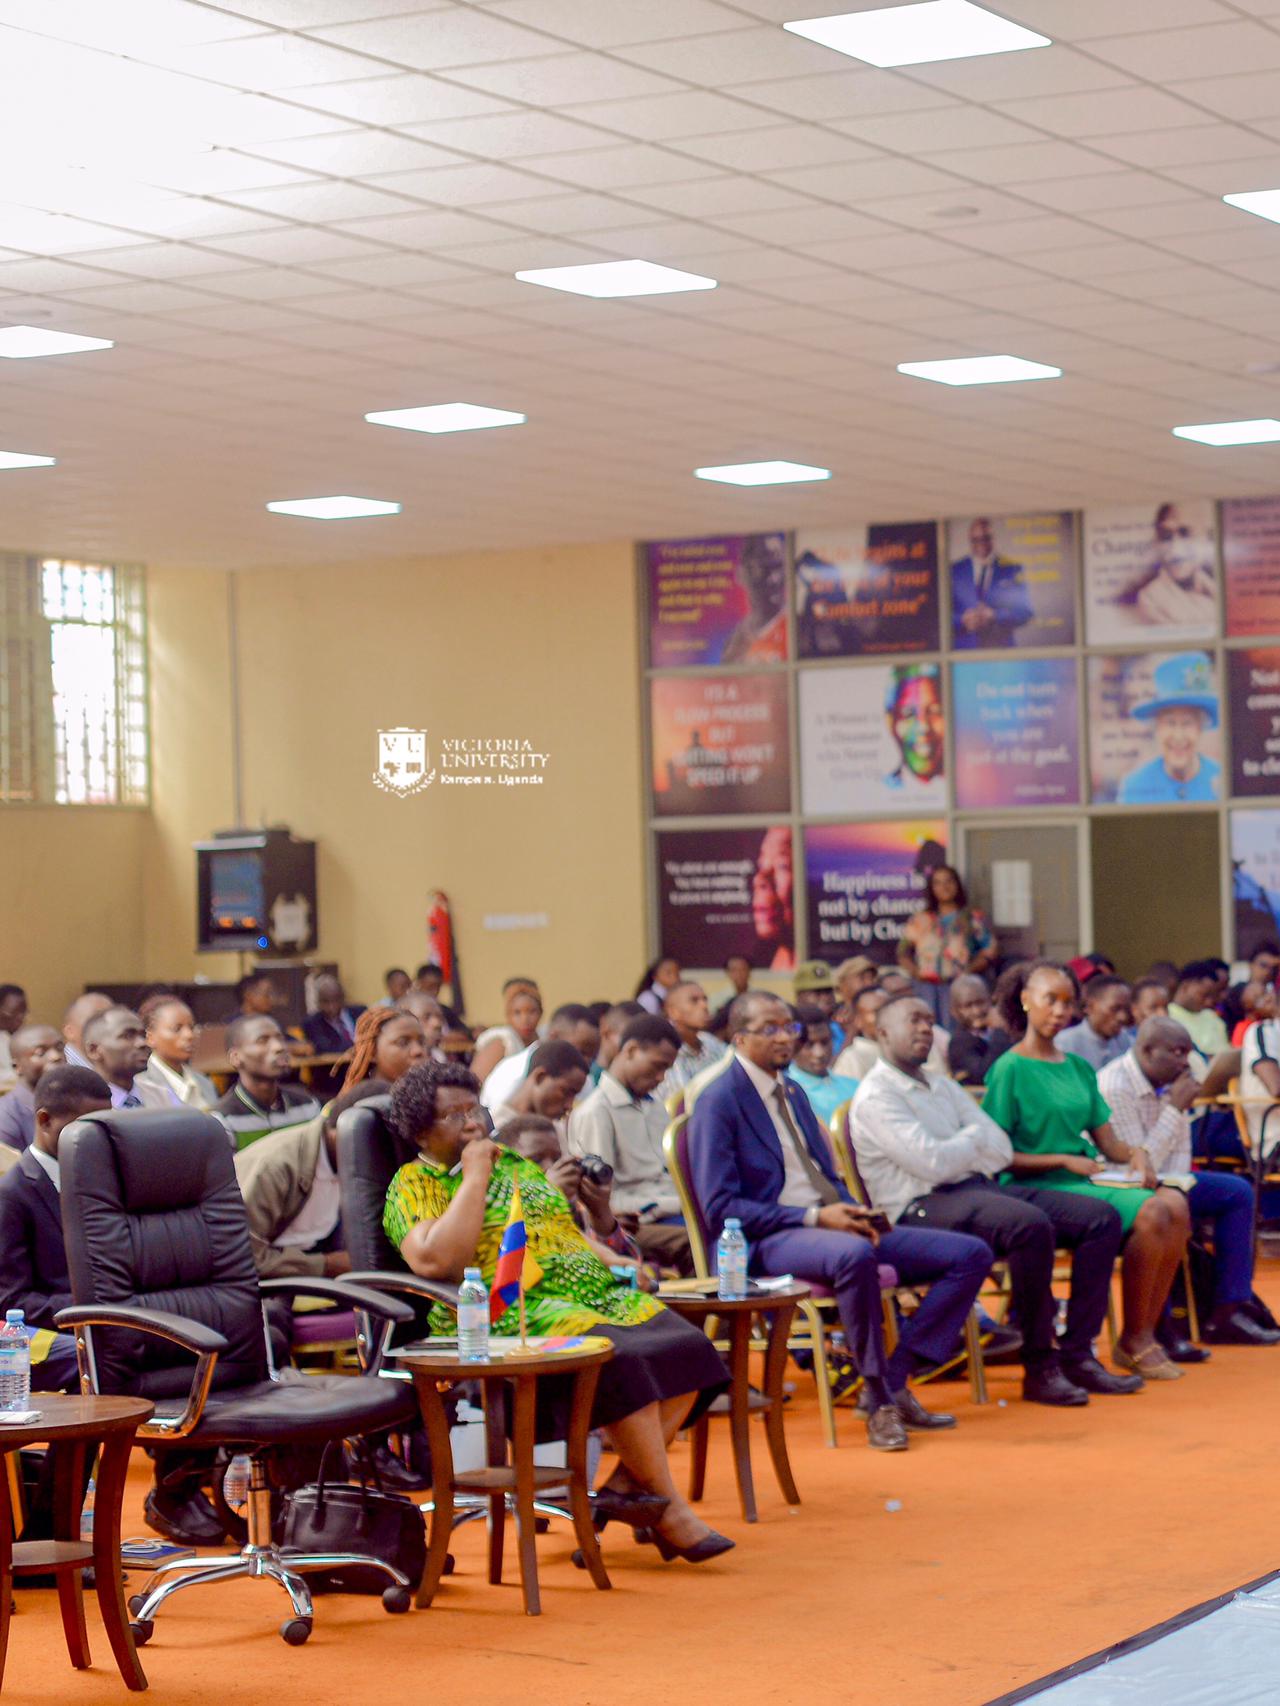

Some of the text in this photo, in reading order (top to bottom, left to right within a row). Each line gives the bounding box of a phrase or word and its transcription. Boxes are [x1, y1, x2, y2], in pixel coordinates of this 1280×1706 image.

[1251, 668, 1280, 687] Not
[1242, 758, 1260, 777] to
[823, 869, 926, 897] Happiness is
[818, 894, 927, 921] not by chance
[820, 918, 905, 946] but by Cho
